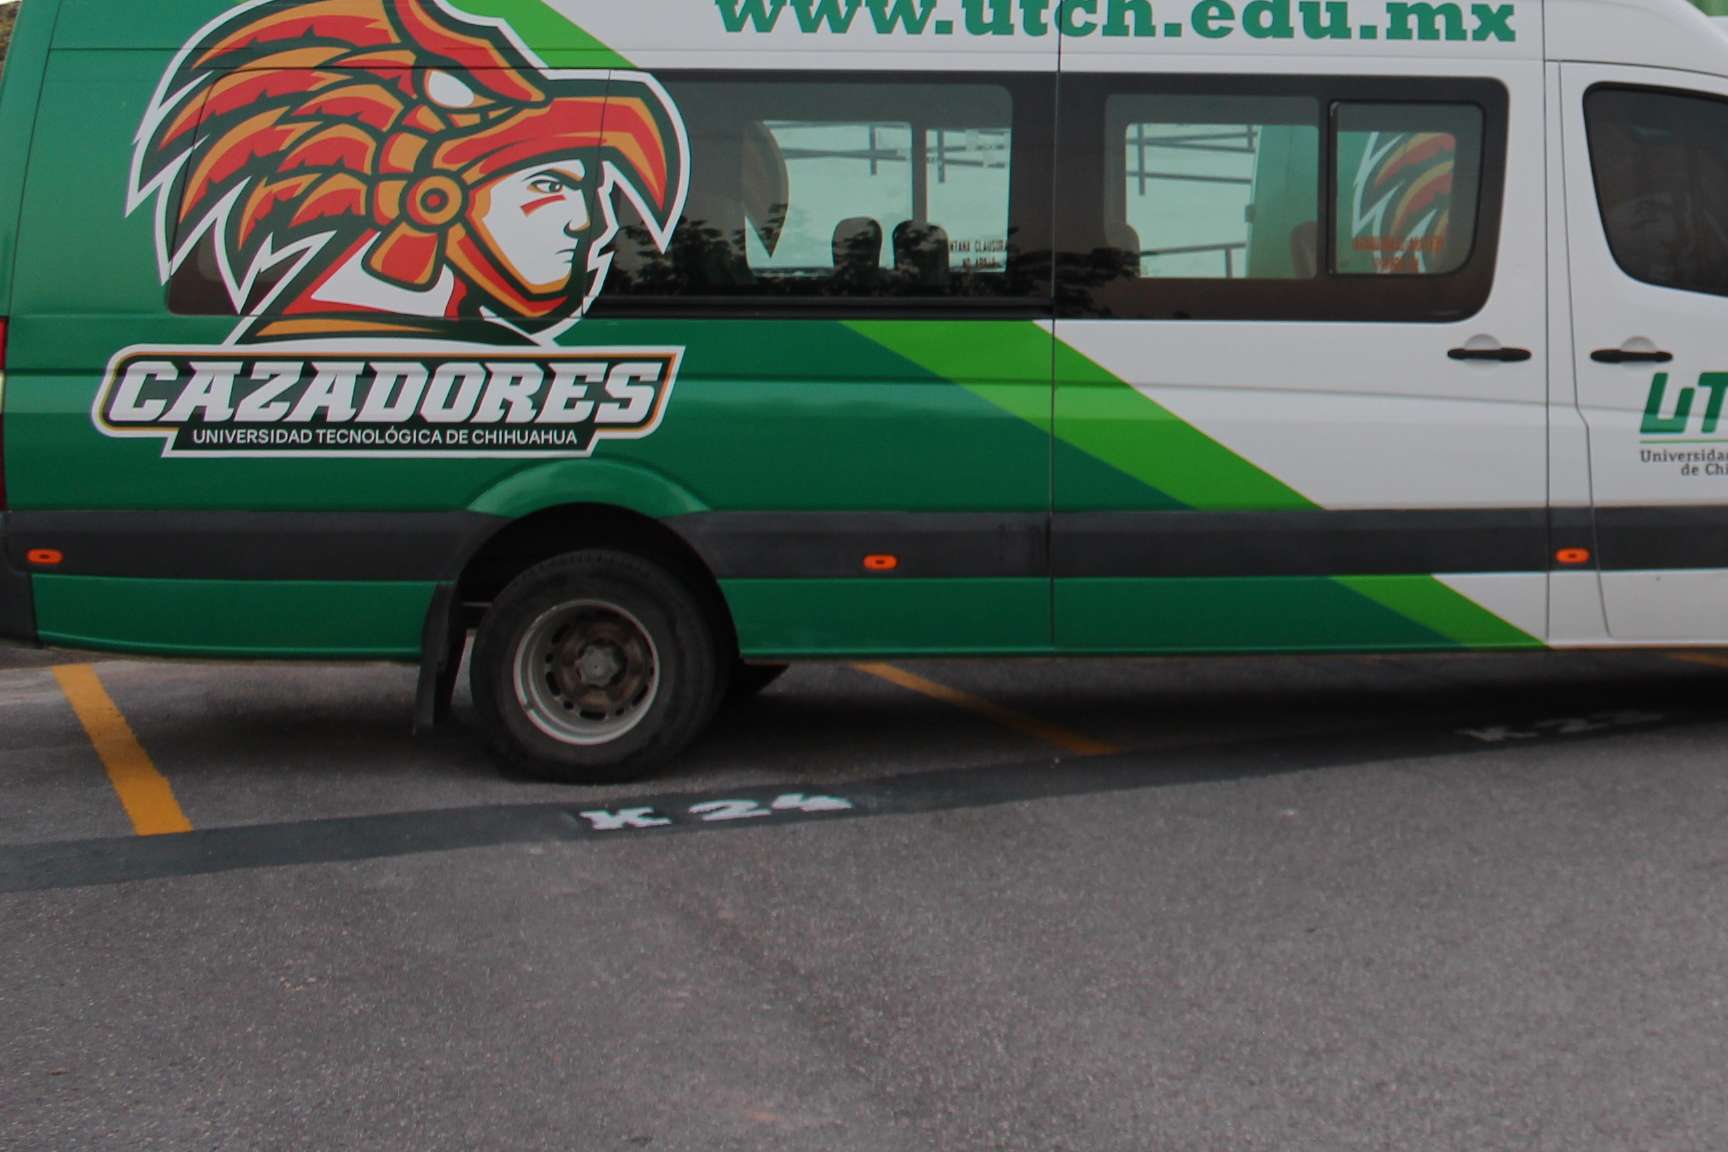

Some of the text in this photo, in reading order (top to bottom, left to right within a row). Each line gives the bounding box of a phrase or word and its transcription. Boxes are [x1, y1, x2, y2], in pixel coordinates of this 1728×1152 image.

[108, 360, 663, 424] CAZADORES
[193, 425, 579, 446] UNIVERSIDAD TECNOLÓGICA DE CHIHUAHUA
[1680, 462, 1700, 477] de
[578, 793, 853, 831] K 24
